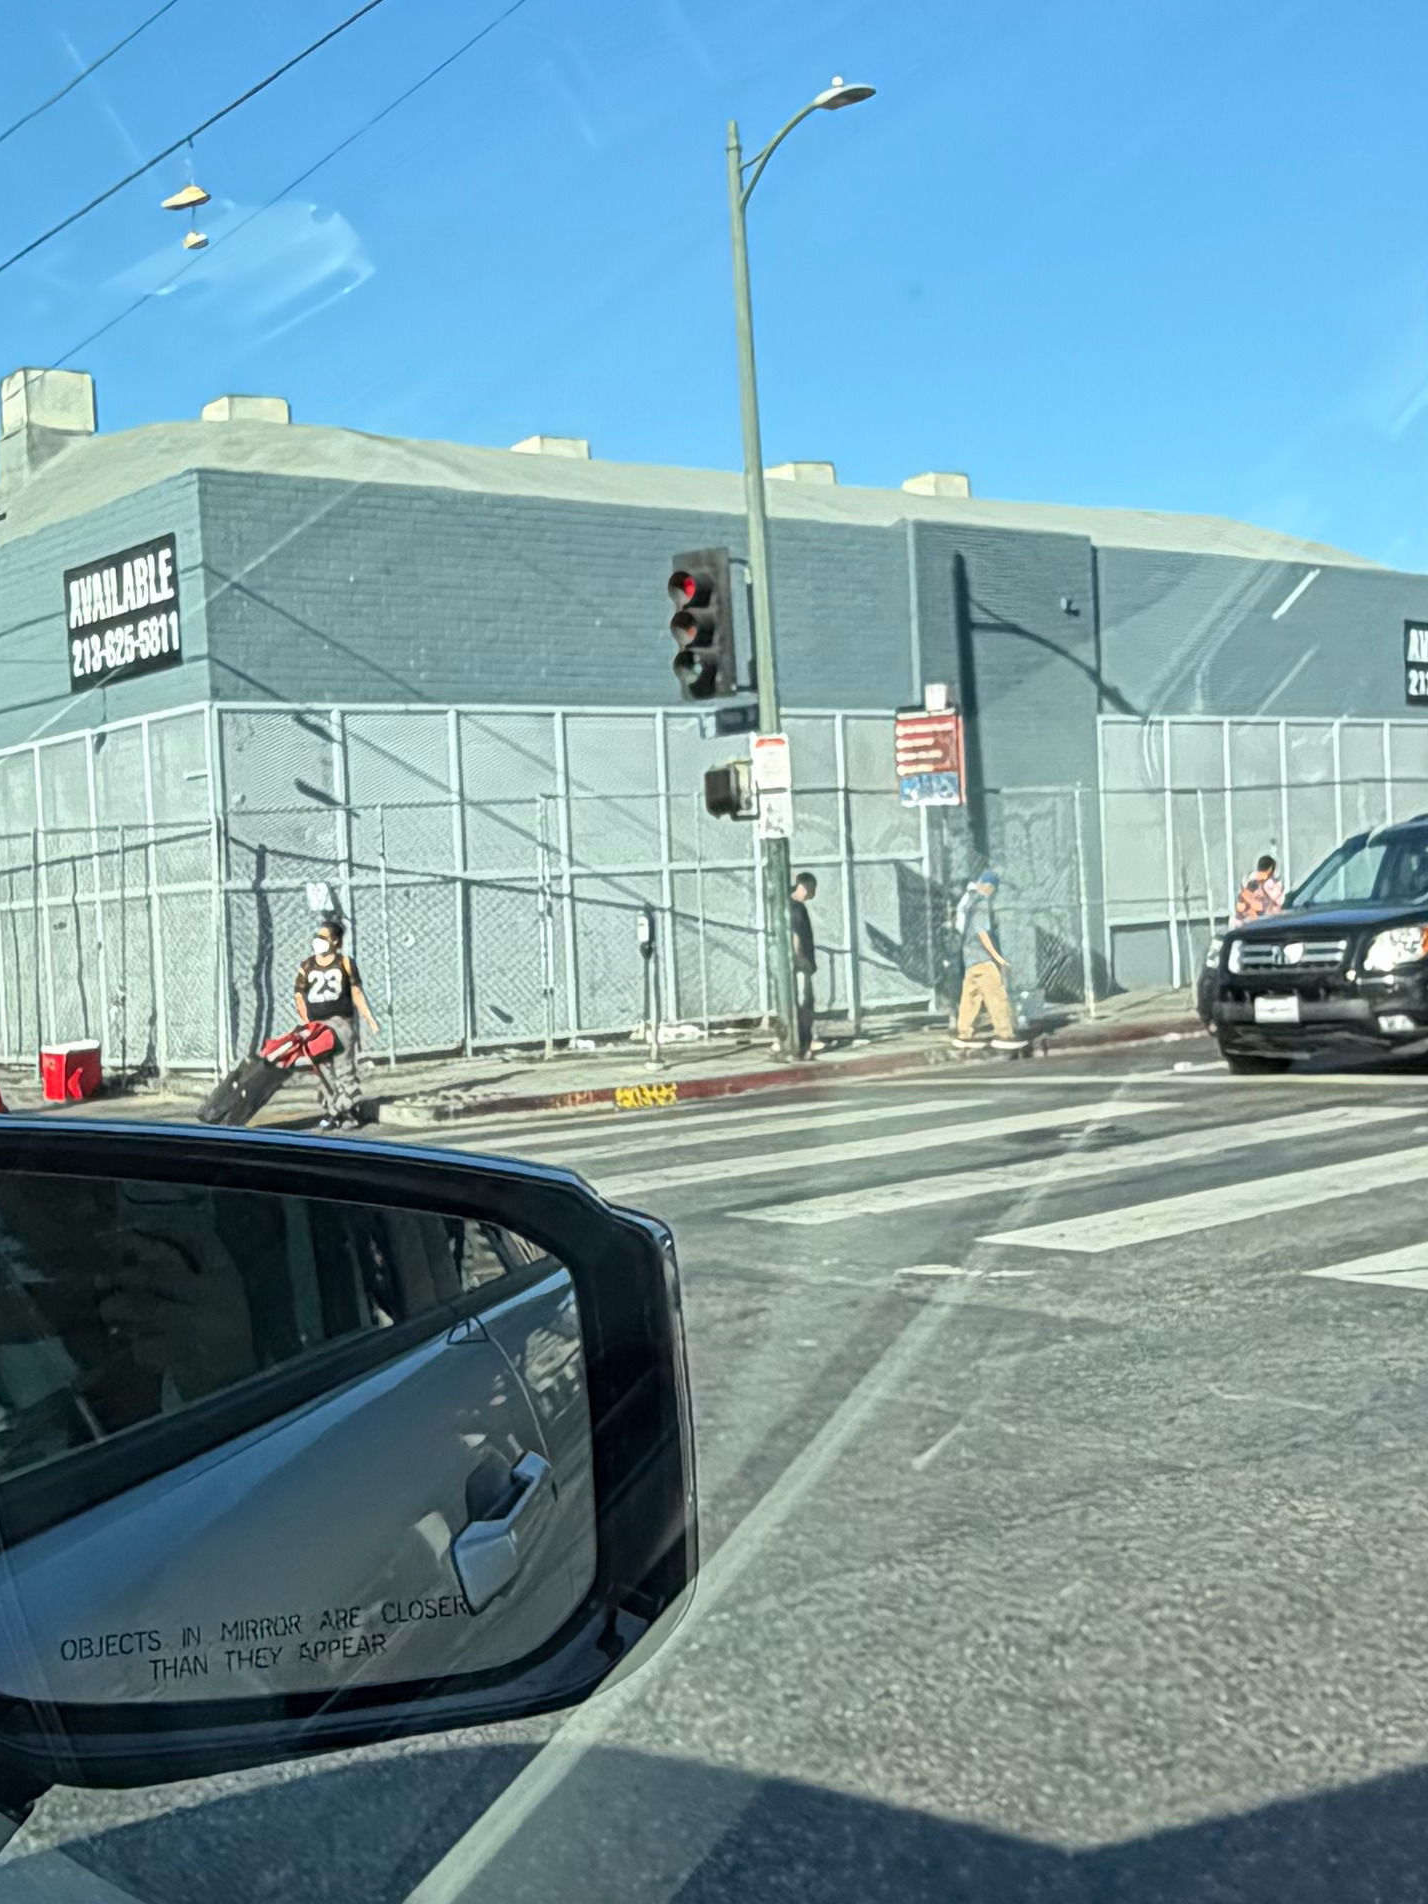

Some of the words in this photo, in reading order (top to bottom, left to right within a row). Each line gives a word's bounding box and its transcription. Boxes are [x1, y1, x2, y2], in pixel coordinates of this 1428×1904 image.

[69, 548, 175, 629] AVAILABLE
[307, 968, 343, 1003] 23
[59, 1629, 163, 1662] OBJECTS
[181, 1625, 202, 1650] IN
[220, 1613, 303, 1643] MIRROR
[319, 1605, 362, 1631] ARE
[380, 1594, 471, 1625] CLOSER
[148, 1654, 209, 1682] THAN
[224, 1646, 284, 1674] THEY
[298, 1633, 388, 1663] APPEAR
